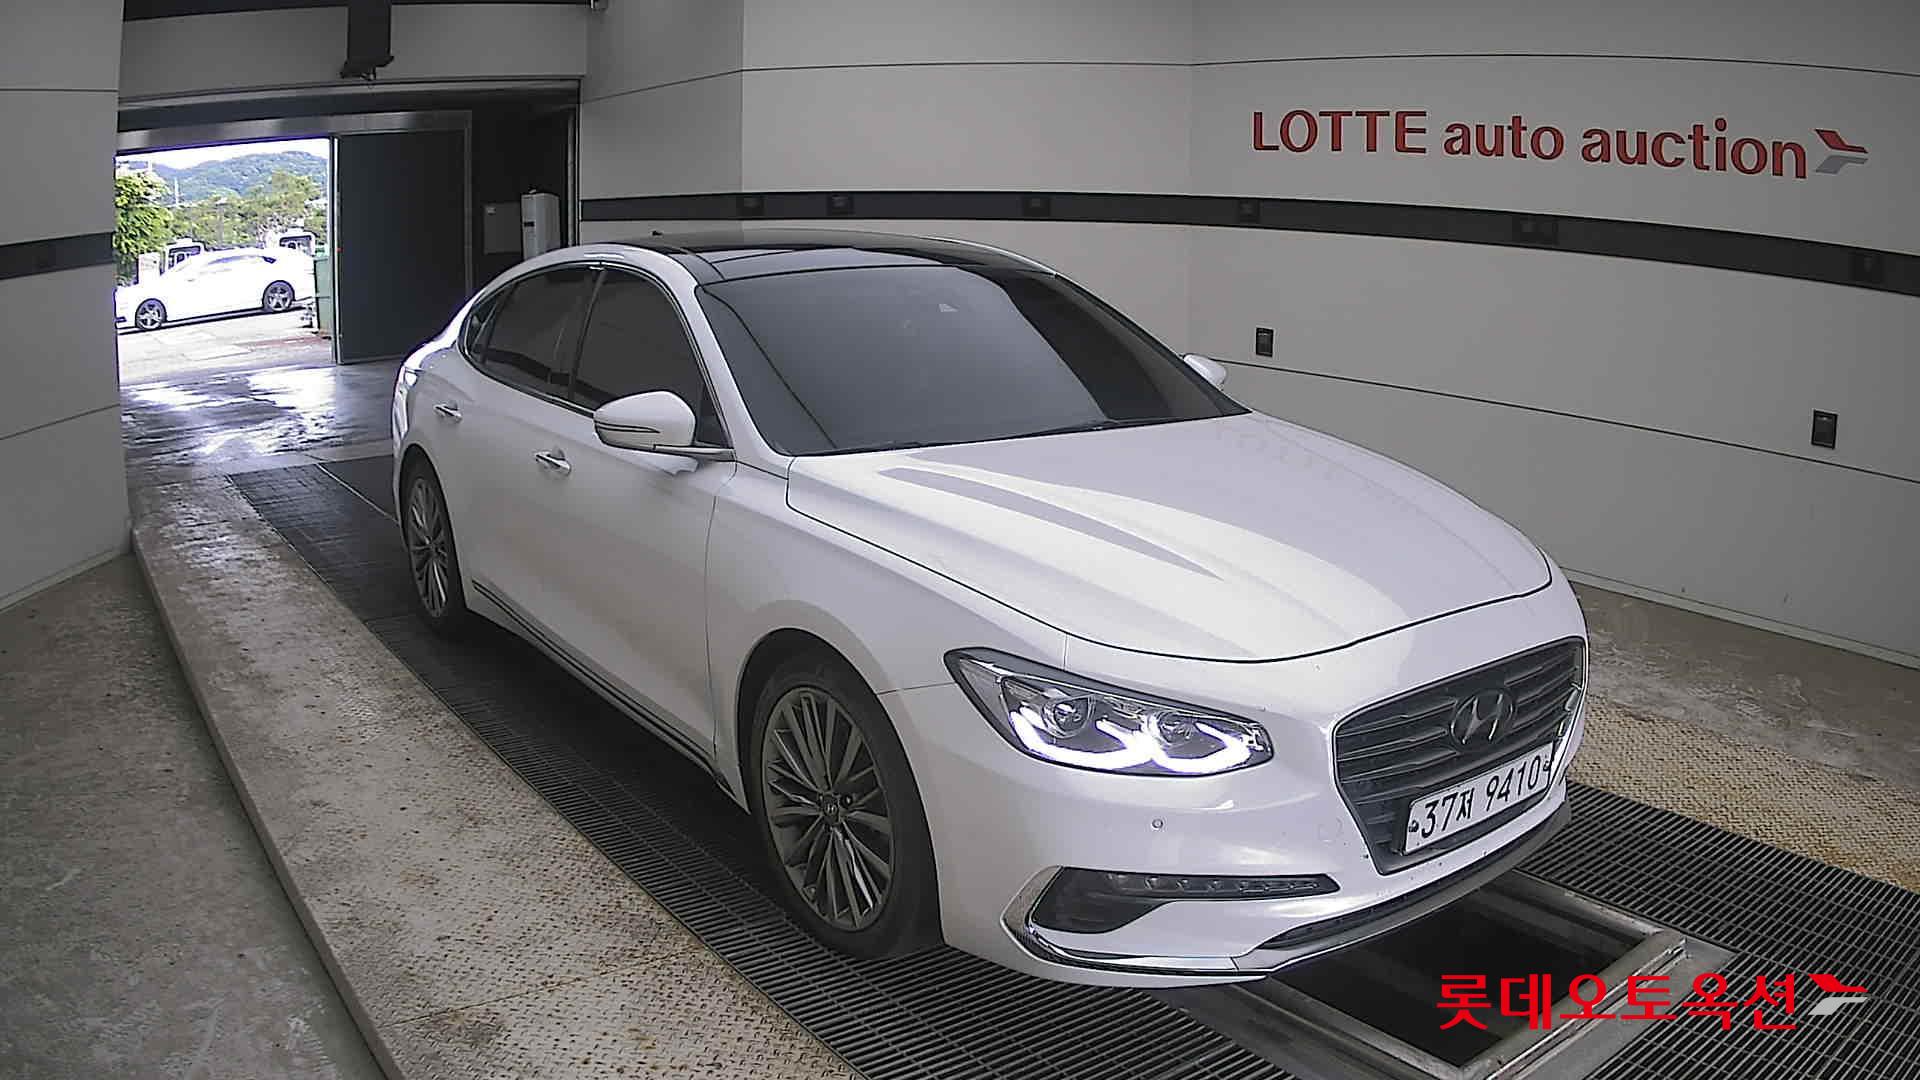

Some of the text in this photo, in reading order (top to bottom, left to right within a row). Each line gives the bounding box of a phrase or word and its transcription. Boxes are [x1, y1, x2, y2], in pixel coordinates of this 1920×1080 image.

[1252, 111, 1808, 179] LOTTE auto auction
[1421, 755, 1541, 839] 37저 9410
